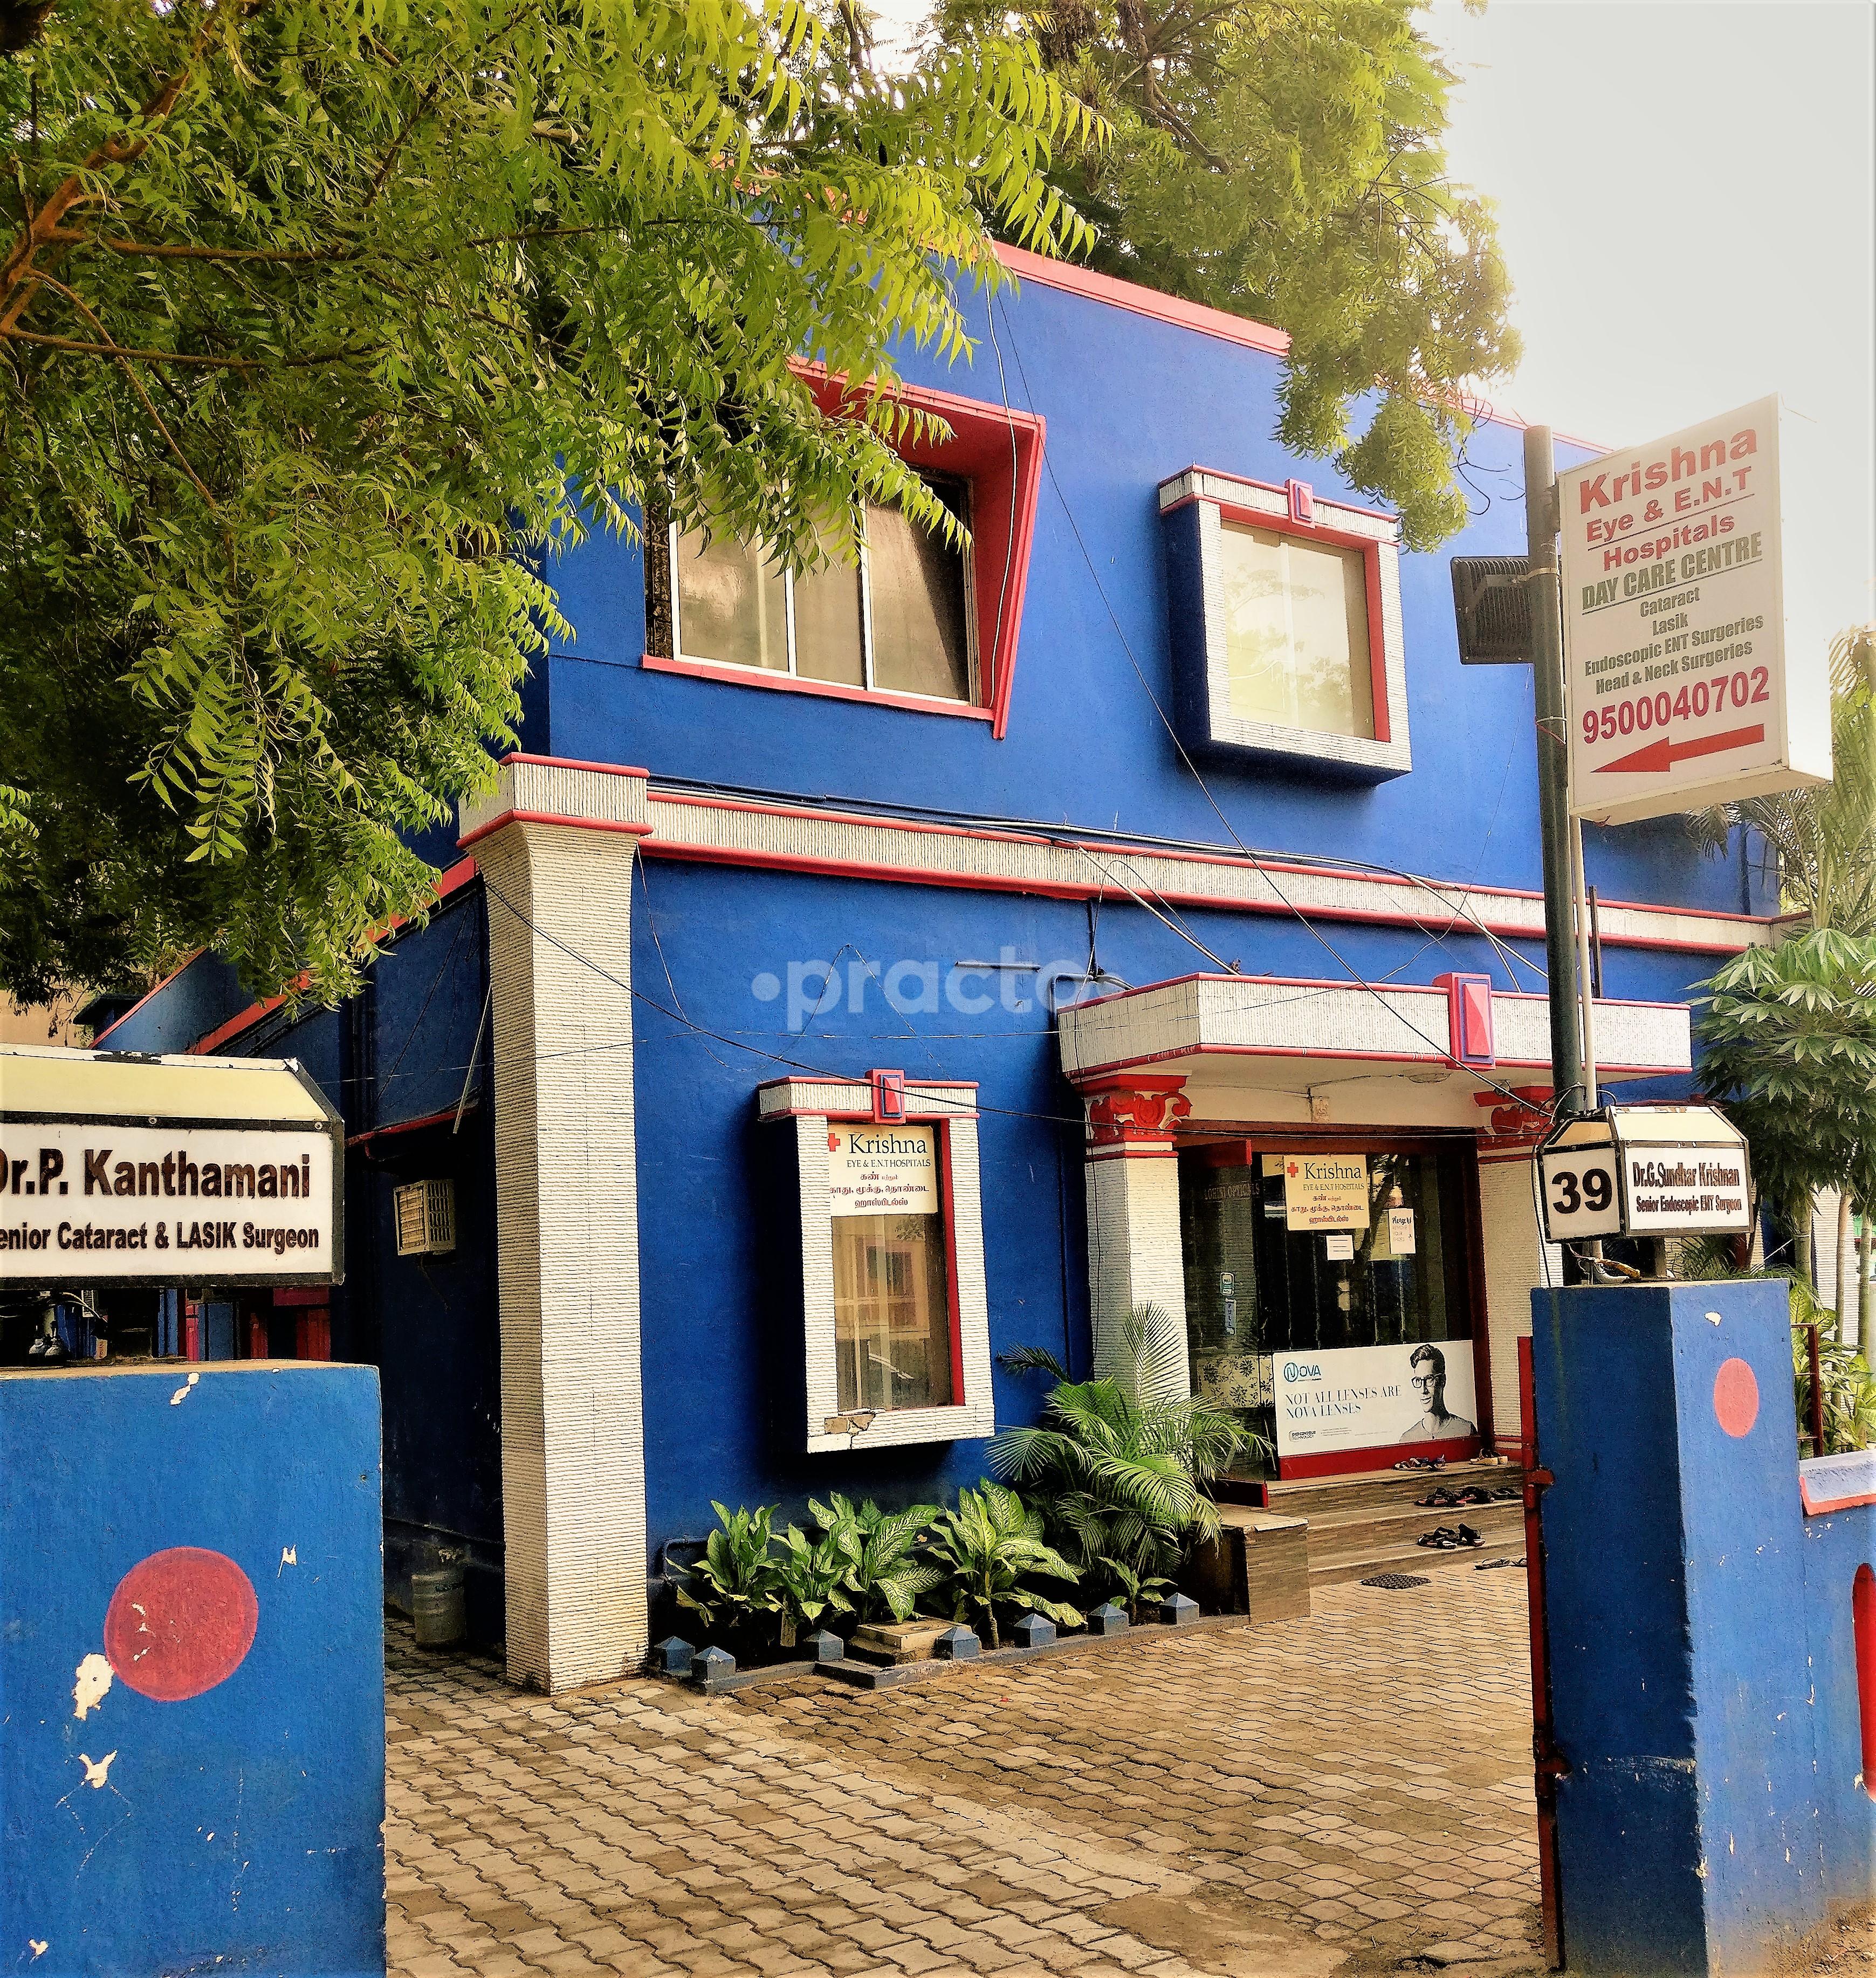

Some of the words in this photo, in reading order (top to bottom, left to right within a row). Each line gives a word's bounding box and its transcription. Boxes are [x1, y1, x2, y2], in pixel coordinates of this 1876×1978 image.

[1580, 429, 1757, 514] Krishna
[1587, 514, 1633, 542] Eye
[1644, 500, 1664, 522] &
[1674, 466, 1752, 512] E.N.T
[1603, 515, 1735, 571] Hospitals
[1582, 577, 1618, 610] DAY
[1623, 559, 1676, 596] CARE
[1681, 532, 1763, 578] CENTRE
[1640, 587, 1700, 617] Cataract
[1652, 612, 1688, 636] Lasik
[1585, 643, 1662, 676] Endoscopic
[1665, 633, 1689, 654] ENT
[1692, 615, 1764, 647] Surgeries
[1596, 672, 1630, 694] Head
[1632, 671, 1643, 685] &
[1645, 660, 1679, 682] Neck
[1681, 641, 1753, 672] Surgeries
[1582, 666, 1769, 744] 9500040702
[848, 1134, 927, 1154] Krishna
[85, 1149, 310, 1198] Kanthamani
[860, 1171, 879, 1180] கண்
[890, 1159, 931, 1167] HOSPITALS
[1304, 1162, 1362, 1180] Krishna
[1699, 1162, 1740, 1187] Krishnan
[1552, 1168, 1612, 1214] 39
[1636, 1196, 1659, 1212] Senior
[1660, 1195, 1699, 1215] Endoscopic
[1715, 1195, 1742, 1215] Surgeon
[0, 1222, 51, 1250] enior
[58, 1221, 148, 1250] Cataract
[155, 1221, 170, 1250] &
[177, 1222, 237, 1249] LASIK
[243, 1222, 319, 1255] Surgeon
[1284, 1362, 1322, 1382] NOVA
[1285, 1393, 1309, 1405] NOT
[1315, 1391, 1335, 1403] ALL
[1337, 1387, 1377, 1402] LENSES
[1381, 1385, 1401, 1397] ARE
[1286, 1406, 1317, 1419] NOVA
[1321, 1402, 1361, 1416] LENSES
